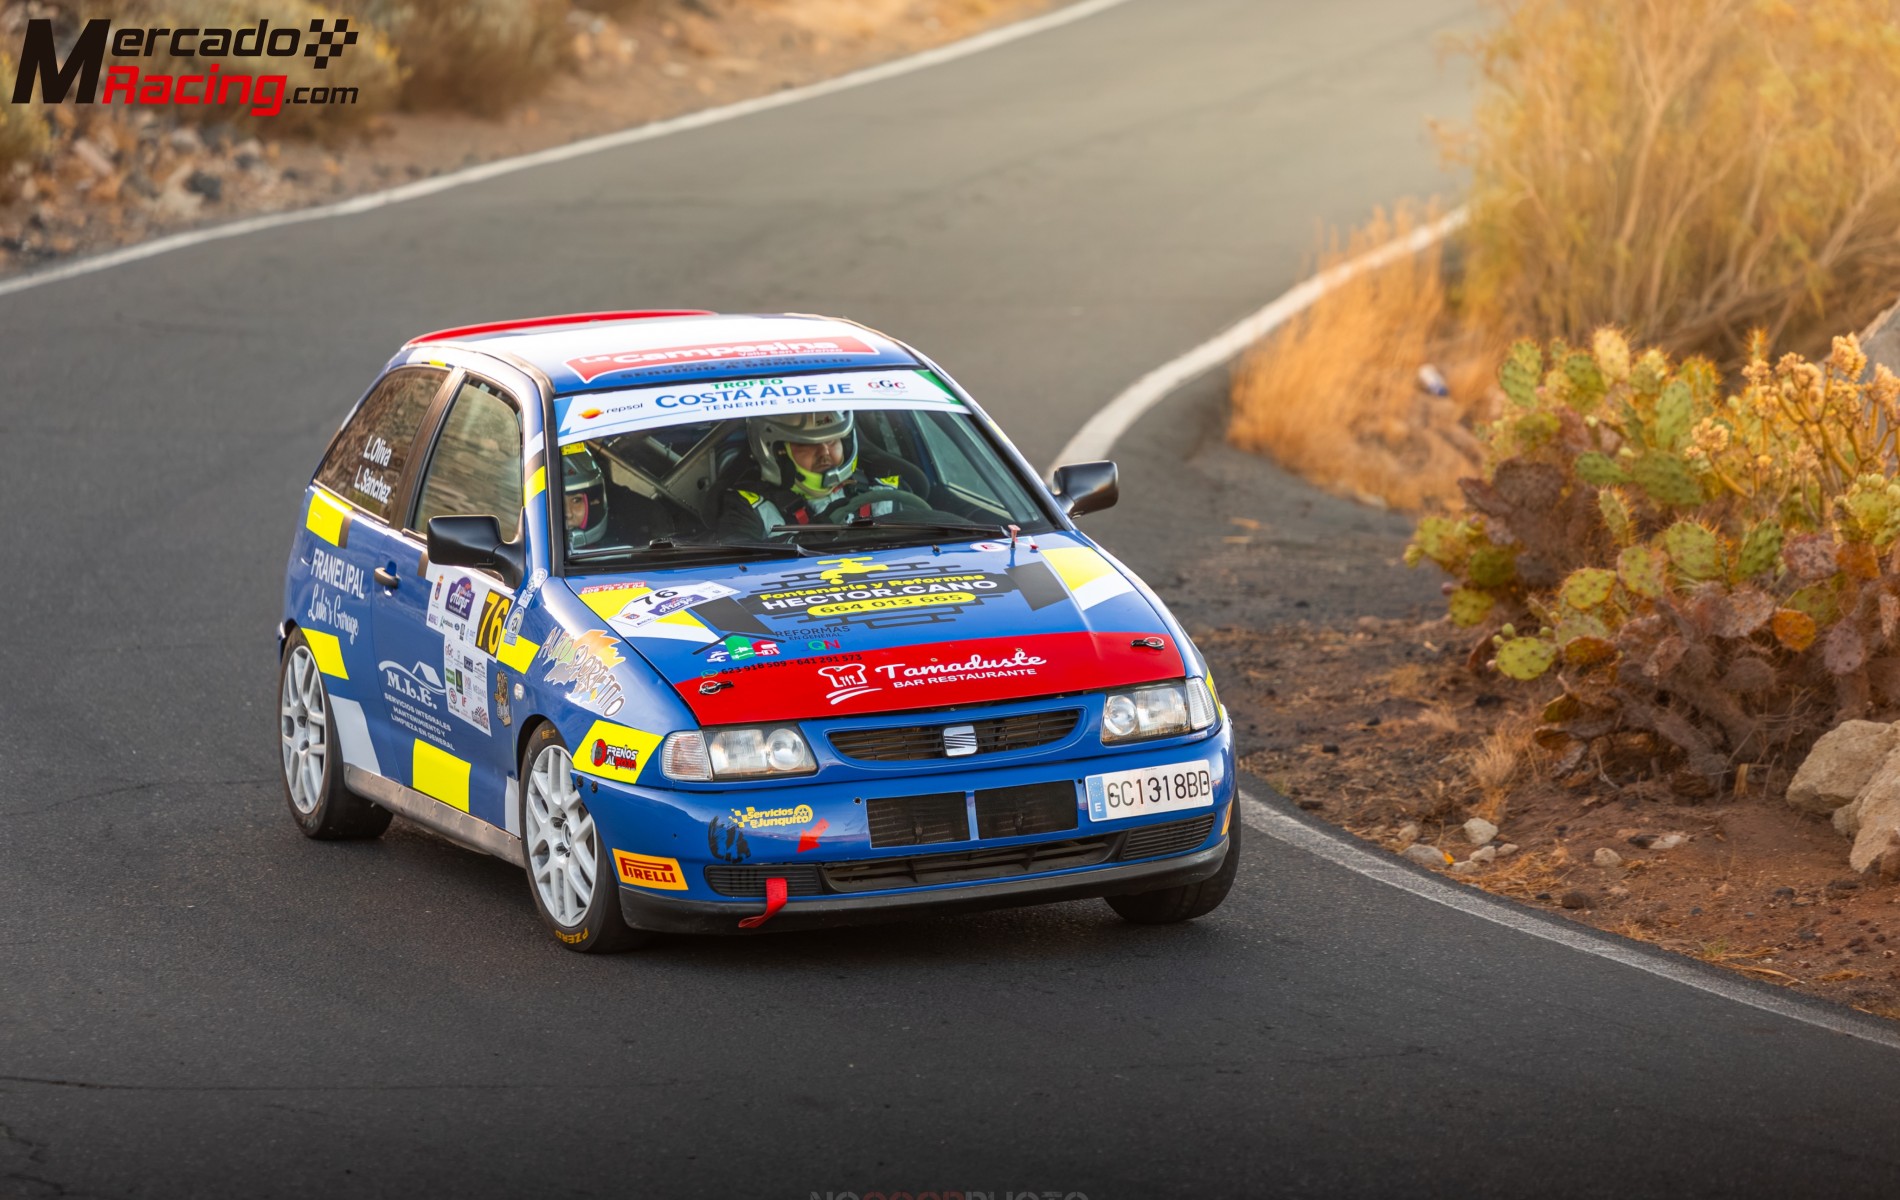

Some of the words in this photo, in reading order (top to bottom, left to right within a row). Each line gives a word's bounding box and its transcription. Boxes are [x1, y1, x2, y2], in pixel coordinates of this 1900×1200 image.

[711, 378, 784, 390] TROFEO
[655, 388, 753, 409] COSTA
[760, 383, 854, 399] ADEJE
[703, 400, 778, 412] TENERIFE
[787, 397, 817, 405] SUR
[606, 403, 644, 415] repsol
[310, 548, 365, 600] FRANELIPAL
[870, 581, 885, 591] y
[886, 574, 986, 587] Reformas
[633, 589, 678, 605] 76
[762, 580, 998, 610] HECTOR.CANO
[819, 602, 864, 614] 664
[871, 598, 913, 608] 013
[919, 594, 964, 604] 665
[477, 591, 510, 655] 76
[775, 625, 851, 638] REFORMAS
[803, 632, 843, 641] GENERAL
[743, 662, 765, 672] 918
[820, 655, 839, 664] 291
[842, 653, 863, 662] 573
[874, 650, 1047, 679] Tamaduste
[893, 676, 925, 689] BAR
[927, 668, 1038, 684] RESTAURANTE
[384, 692, 415, 713] SERVICIOS
[415, 706, 452, 732] INTEGRALES
[393, 706, 441, 735] MANTENIMIENTO
[391, 712, 418, 732] LIMPIEZA
[427, 732, 456, 751] GENERAL
[1106, 770, 1210, 808] GC1318BD
[747, 808, 794, 820] Servicios
[1094, 802, 1103, 813] E
[619, 856, 677, 883] PIRELLI
